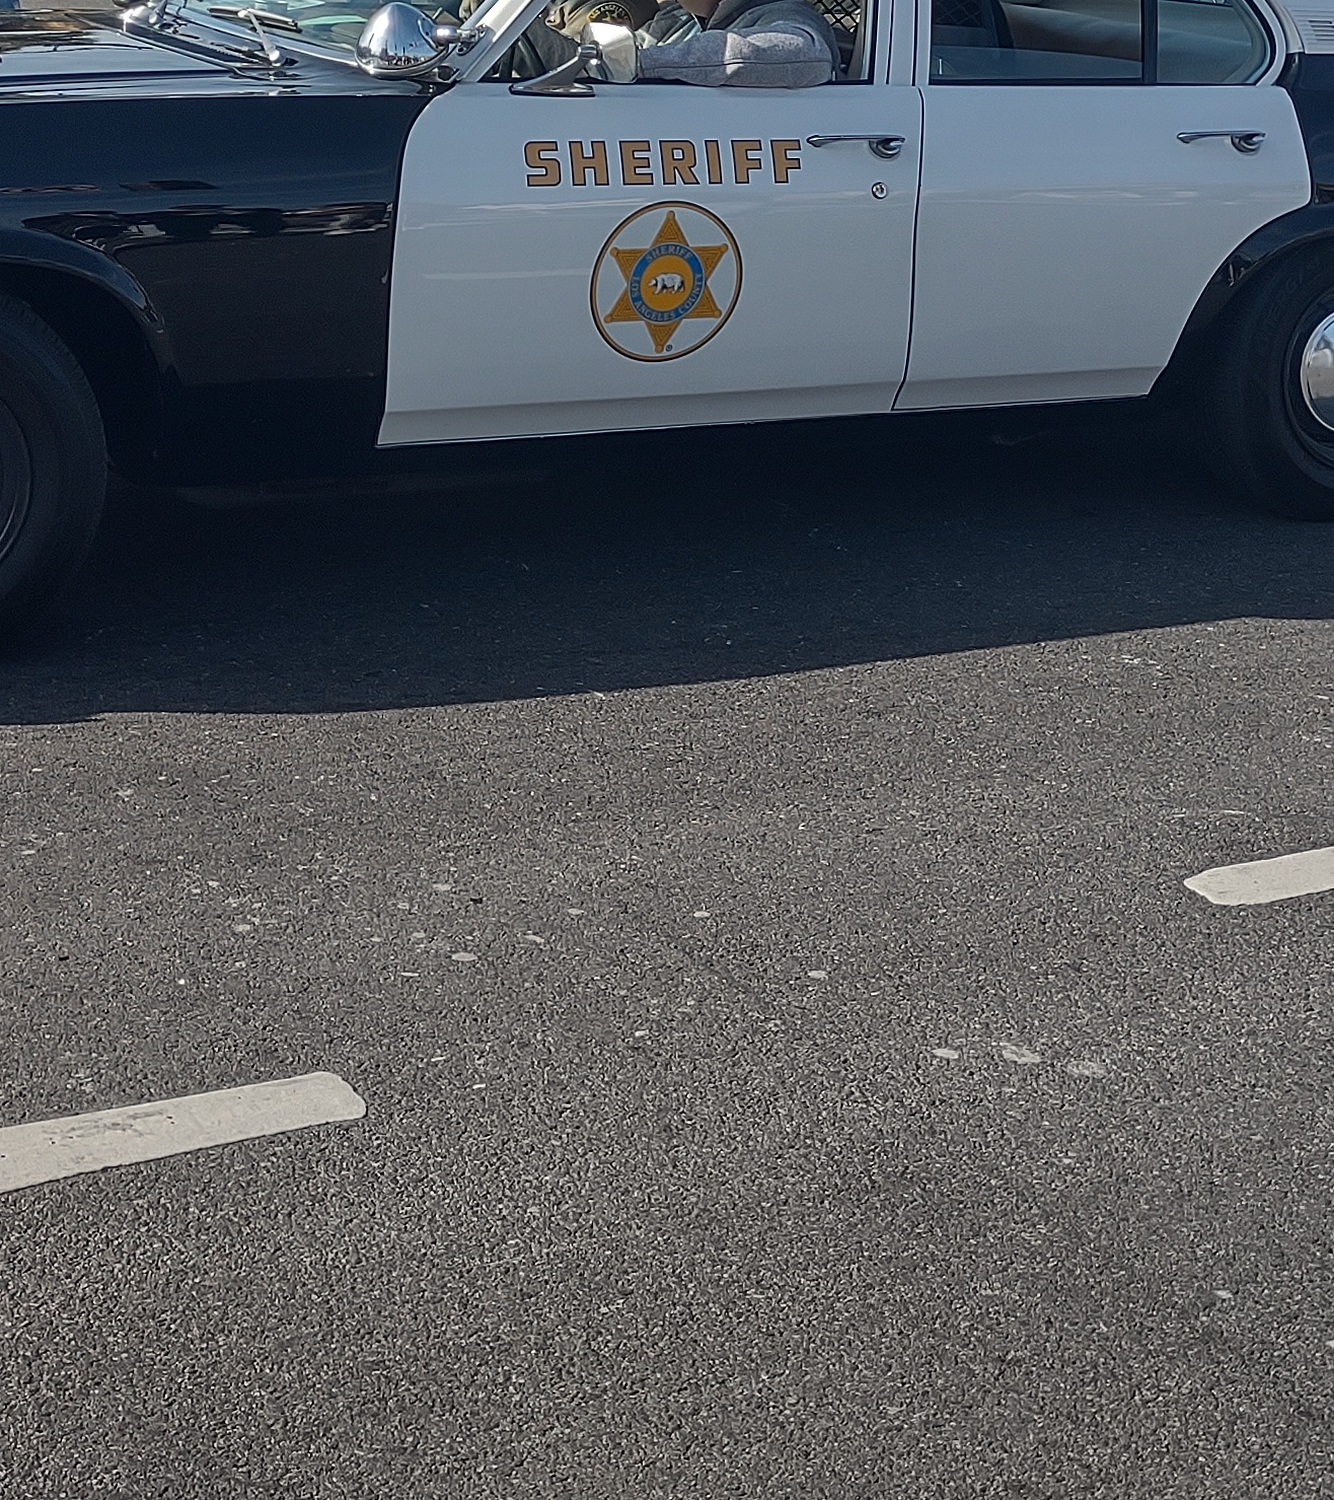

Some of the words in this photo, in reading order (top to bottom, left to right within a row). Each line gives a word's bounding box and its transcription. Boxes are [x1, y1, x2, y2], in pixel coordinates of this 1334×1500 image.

[524, 139, 802, 187] SHERIFF
[647, 244, 693, 264] SHERIFF
[630, 275, 640, 298] LOS
[678, 273, 703, 315] COUNTY
[634, 300, 676, 322] ANGELES
